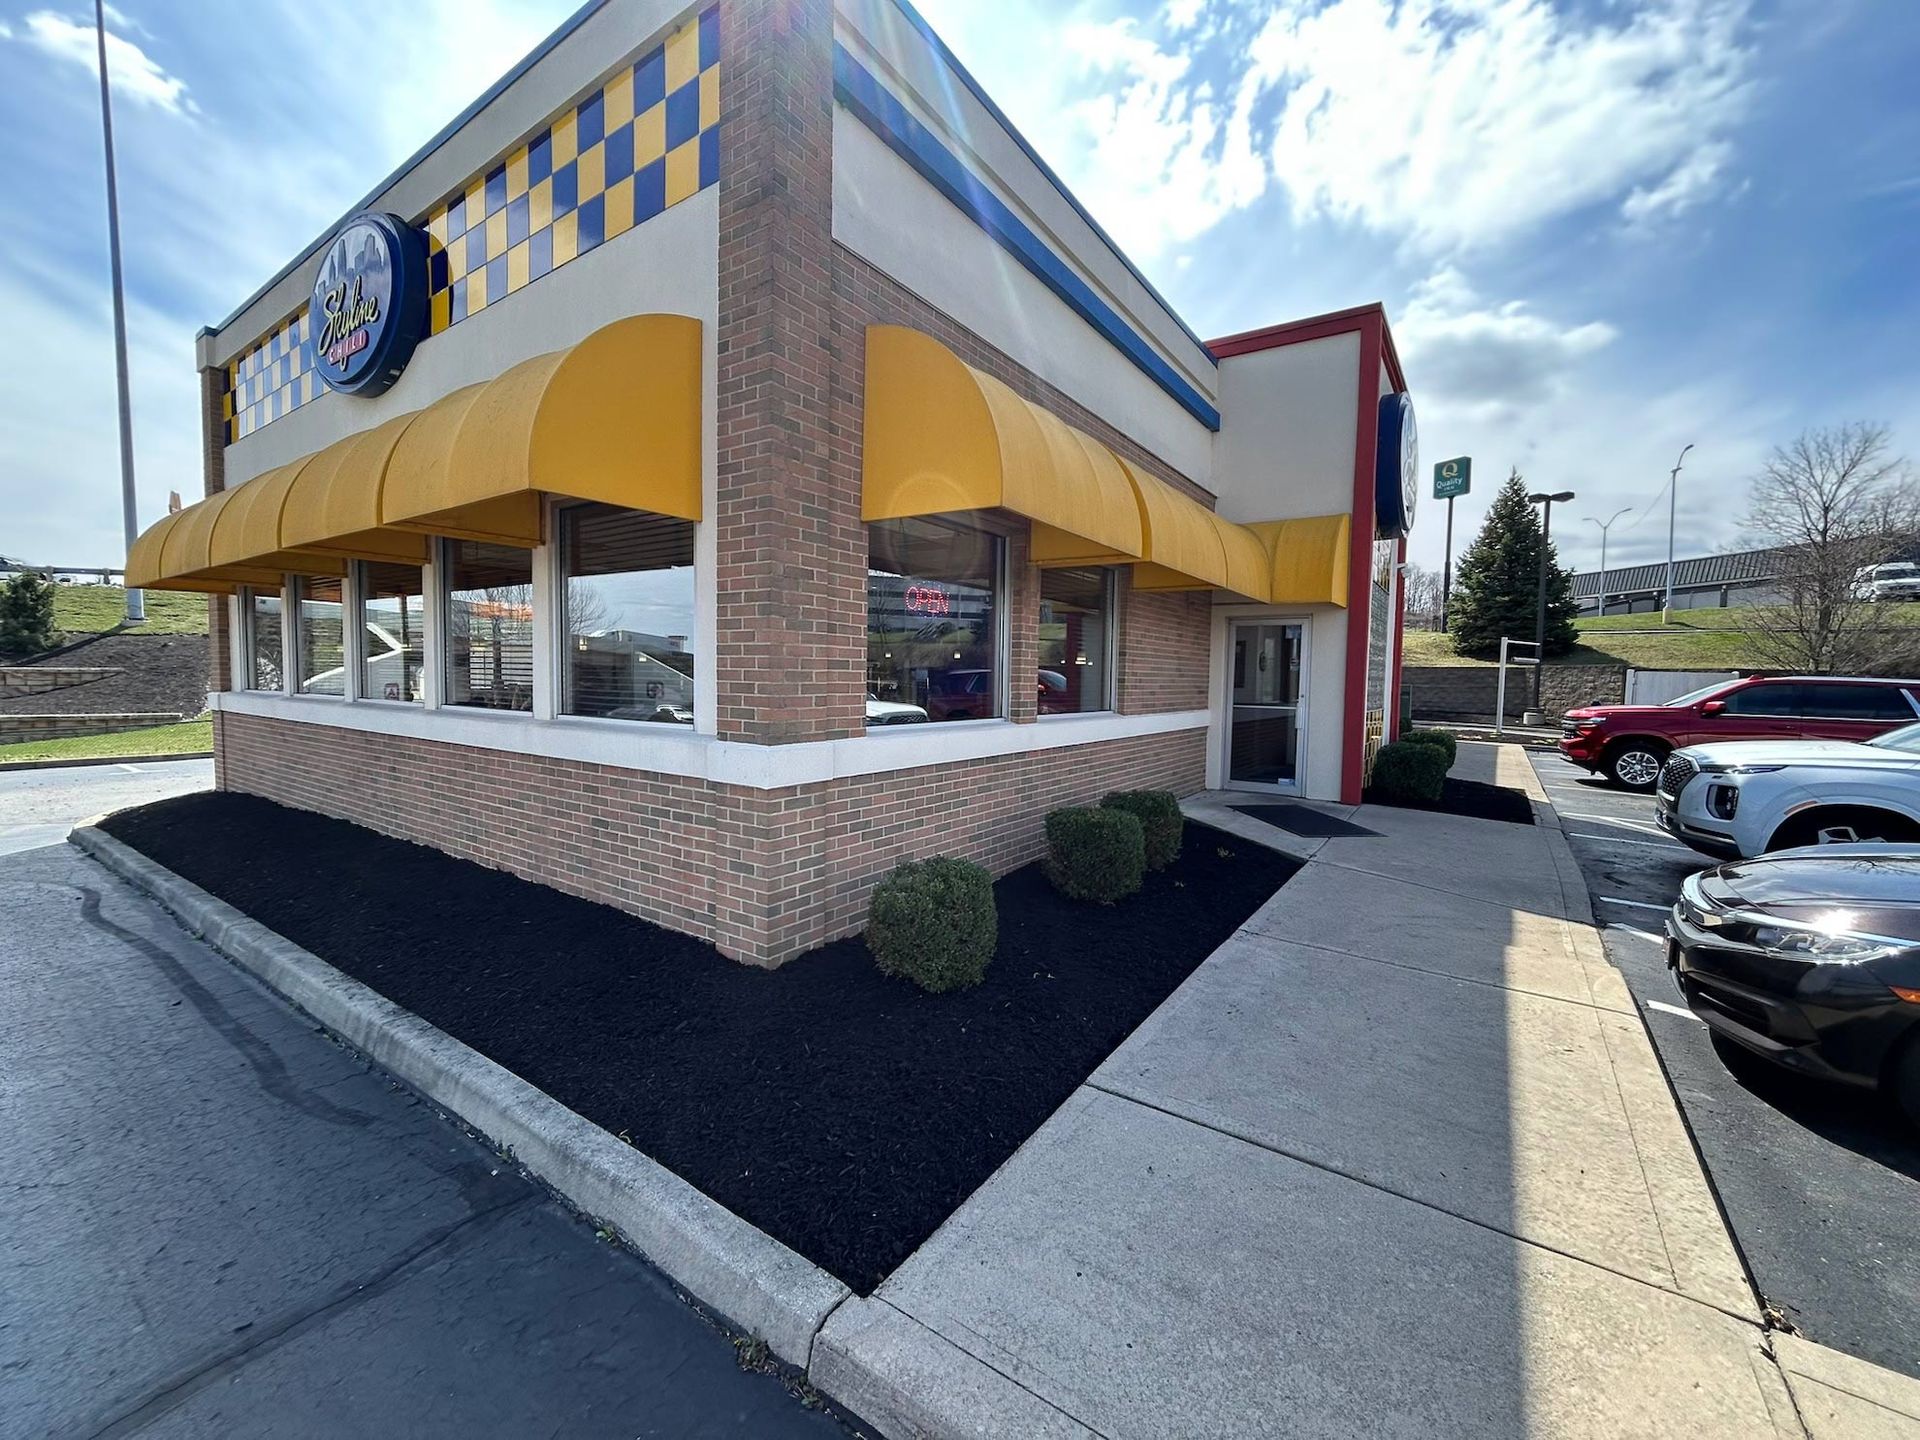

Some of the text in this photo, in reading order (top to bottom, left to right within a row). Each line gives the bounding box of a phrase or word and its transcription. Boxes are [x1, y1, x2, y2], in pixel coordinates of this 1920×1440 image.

[318, 275, 379, 371] Skyline
[329, 332, 364, 362] CHILI
[1436, 477, 1463, 489] Quality
[1442, 462, 1458, 478] Q
[906, 586, 949, 614] OPEN
